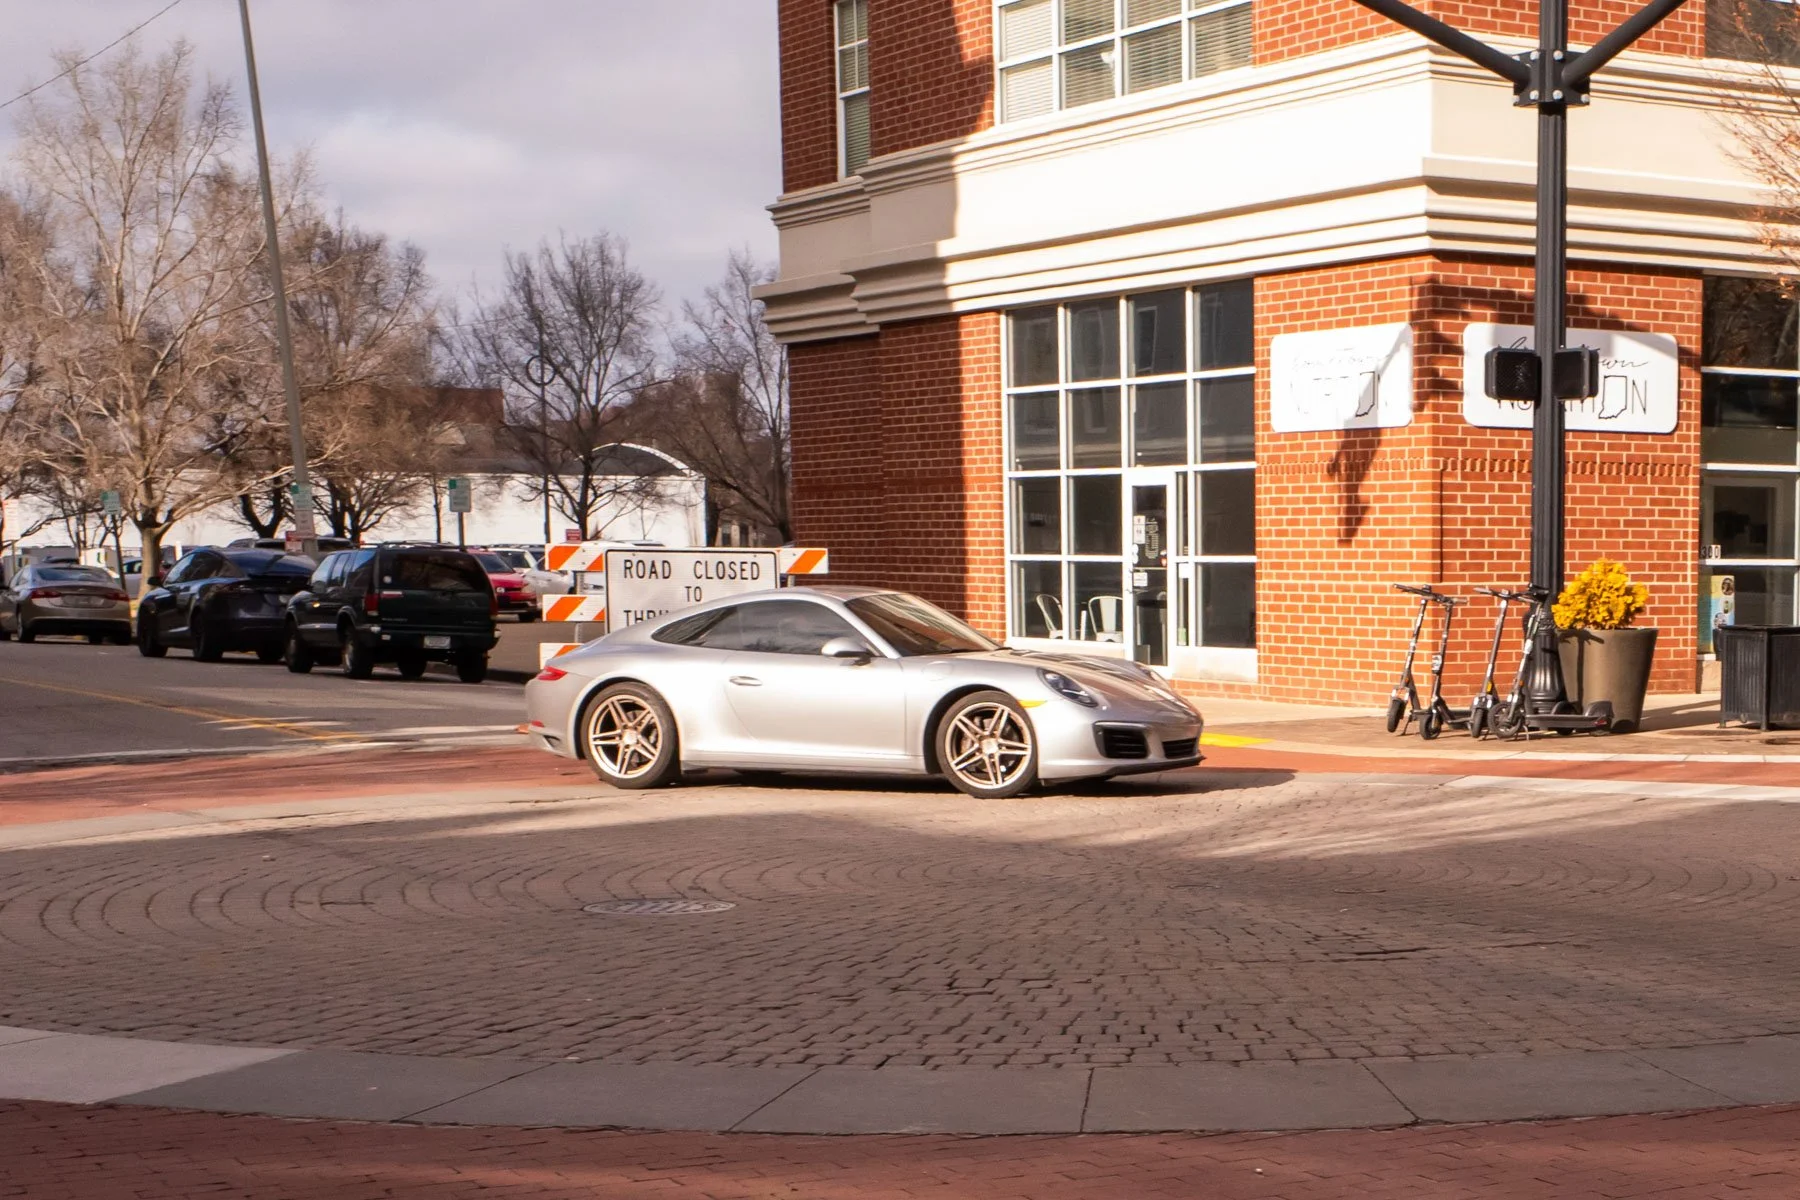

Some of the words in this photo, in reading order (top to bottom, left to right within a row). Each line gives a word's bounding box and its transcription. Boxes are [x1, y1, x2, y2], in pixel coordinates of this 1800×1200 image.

[624, 559, 672, 579] ROAD
[693, 560, 760, 580] CLOSED
[685, 586, 702, 602] TO
[623, 610, 669, 627] THR
